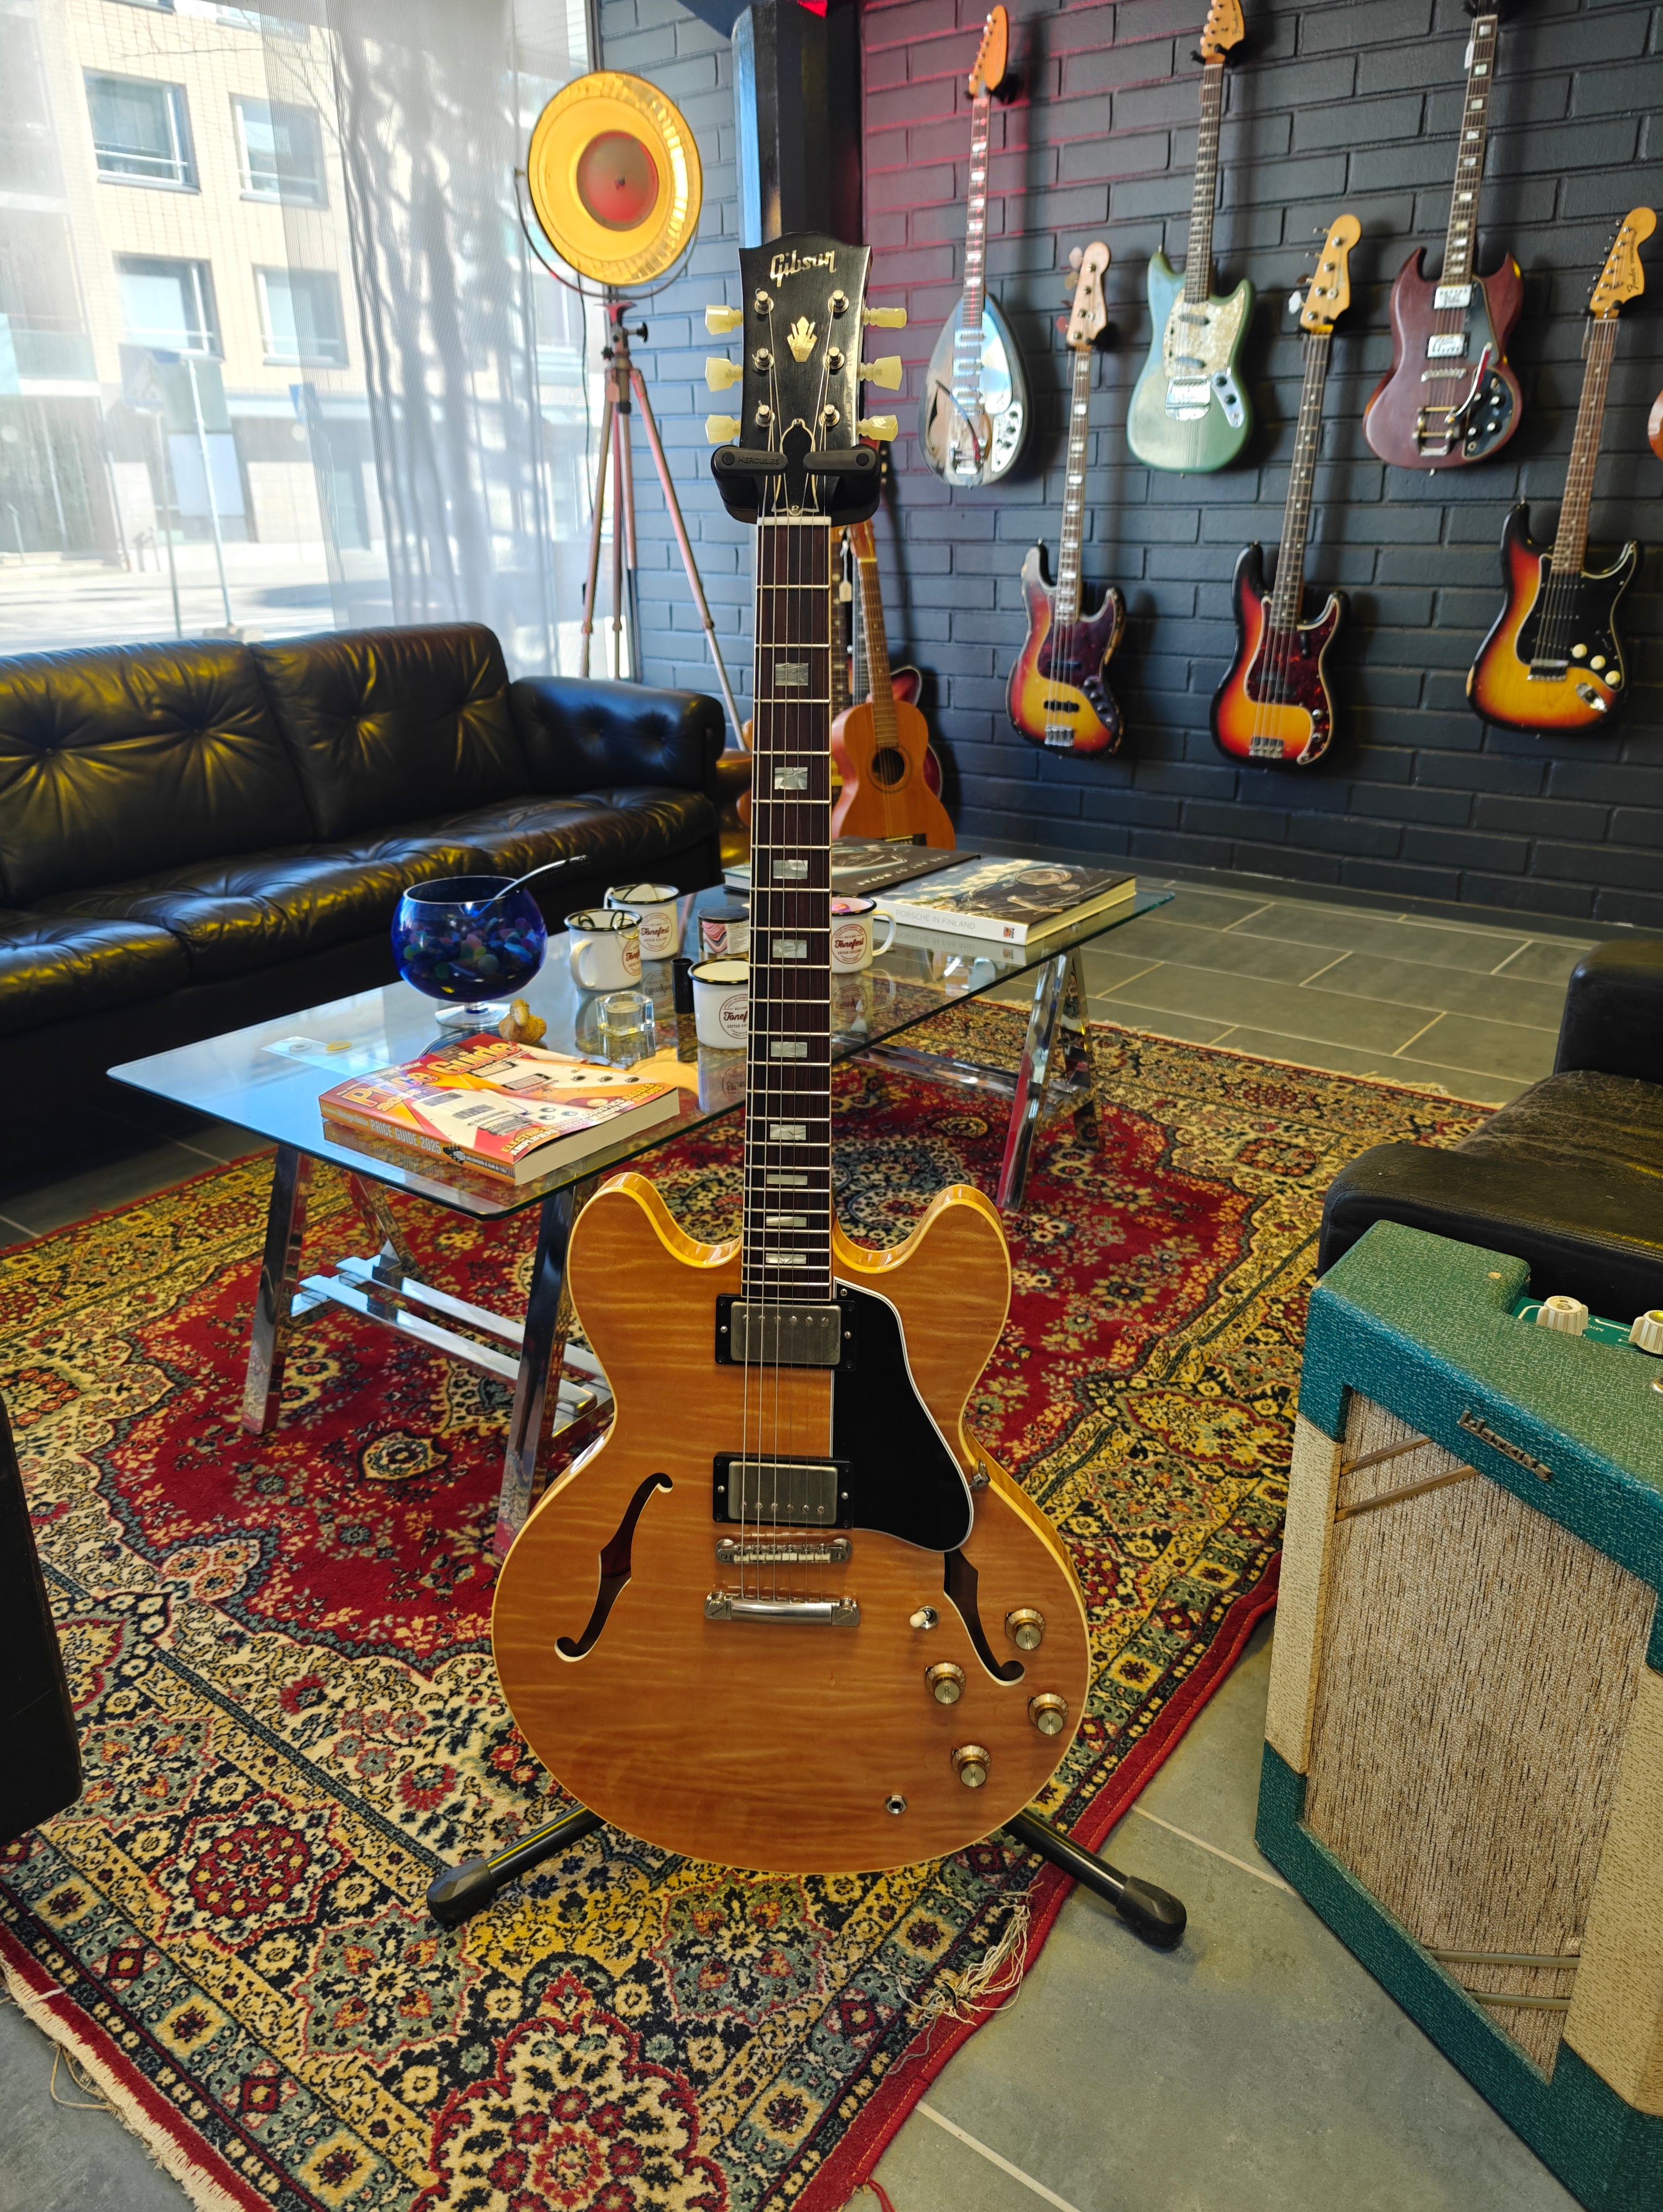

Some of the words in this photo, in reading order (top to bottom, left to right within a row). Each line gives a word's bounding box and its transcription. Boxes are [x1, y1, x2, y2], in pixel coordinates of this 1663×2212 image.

[770, 249, 836, 288] Gibson
[641, 926, 670, 937] Tonefest
[896, 909, 929, 922] PORSCHE
[932, 915, 940, 925] IN
[942, 918, 975, 930] FINLAND
[834, 937, 864, 950] Tonefest
[723, 1010, 748, 1023] Tonef
[342, 1072, 438, 1108] Price
[427, 1043, 521, 1076] Guide
[500, 1127, 546, 1153] ELECTRIC
[622, 1083, 656, 1100] BASSES
[510, 1129, 559, 1156] AMPLIFIERS
[632, 1085, 663, 1102] BANJOS
[370, 1119, 394, 1138] PRICE
[394, 1126, 419, 1147] GUIDE
[419, 1135, 442, 1155] 2025
